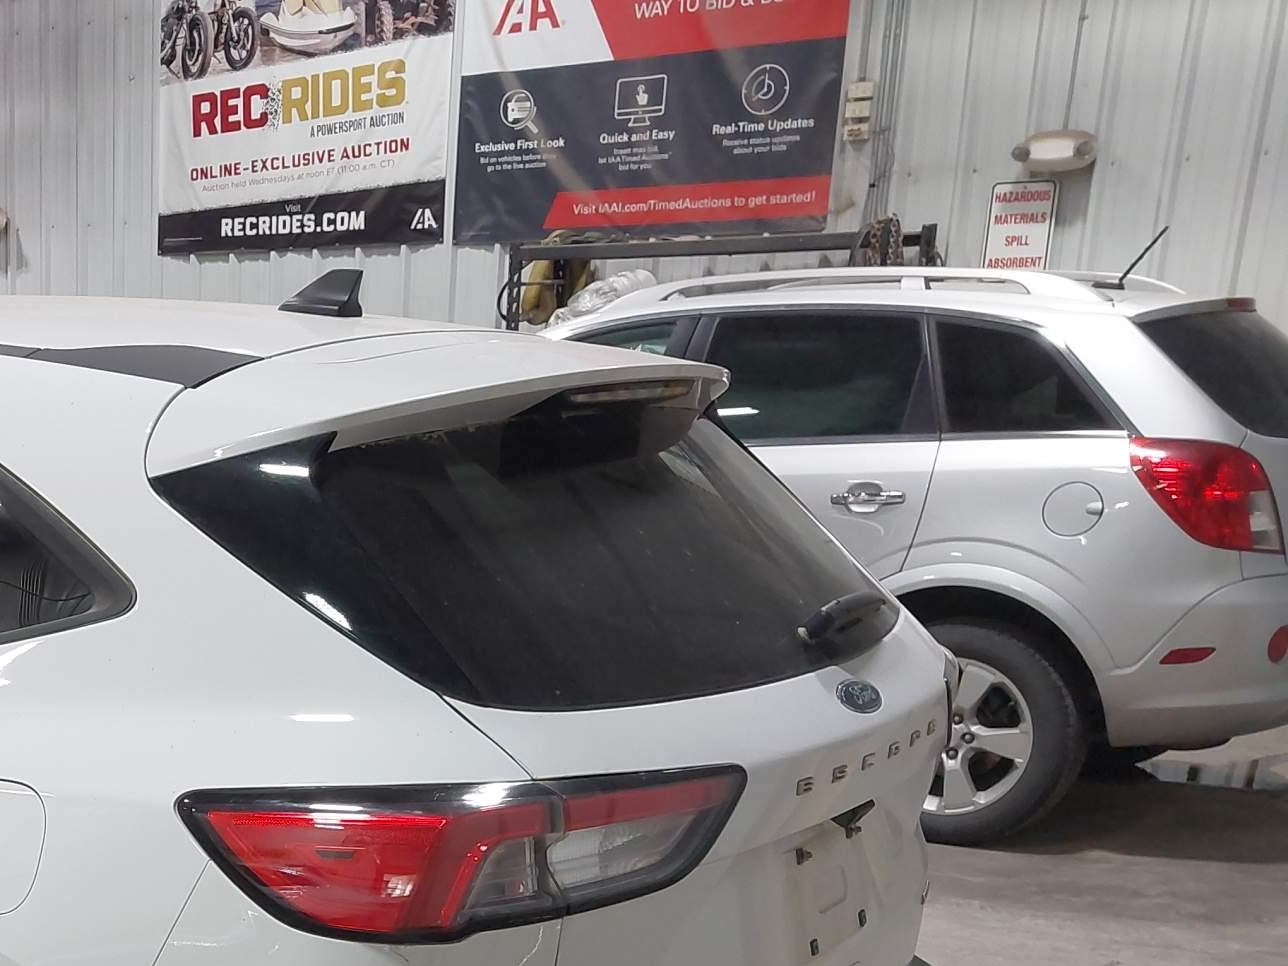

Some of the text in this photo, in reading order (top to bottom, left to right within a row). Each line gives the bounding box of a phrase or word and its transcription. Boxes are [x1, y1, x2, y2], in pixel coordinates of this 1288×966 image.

[634, 0, 672, 19] WAY
[191, 58, 407, 138] REC RIDES
[310, 112, 405, 138] A POWERSPORT AUCTION
[712, 118, 815, 135] Real-Time Updates
[600, 129, 675, 144] Quick and Easy
[475, 137, 565, 152] Exclusive First Look
[190, 137, 411, 182] ONLINE-EXCLUSIVE AUCTION
[201, 181, 229, 192] Auction
[572, 202, 596, 215] Visit
[734, 196, 745, 207] to
[748, 195, 767, 208] get
[769, 190, 815, 204] started!
[994, 190, 1051, 203] HAZARDOUS
[285, 203, 302, 213] Visit
[220, 210, 366, 237] RECRIDES.COM
[993, 212, 1048, 225] MATERIALS
[1004, 235, 1030, 247] SPILL
[986, 256, 1043, 269] ABSORBENT
